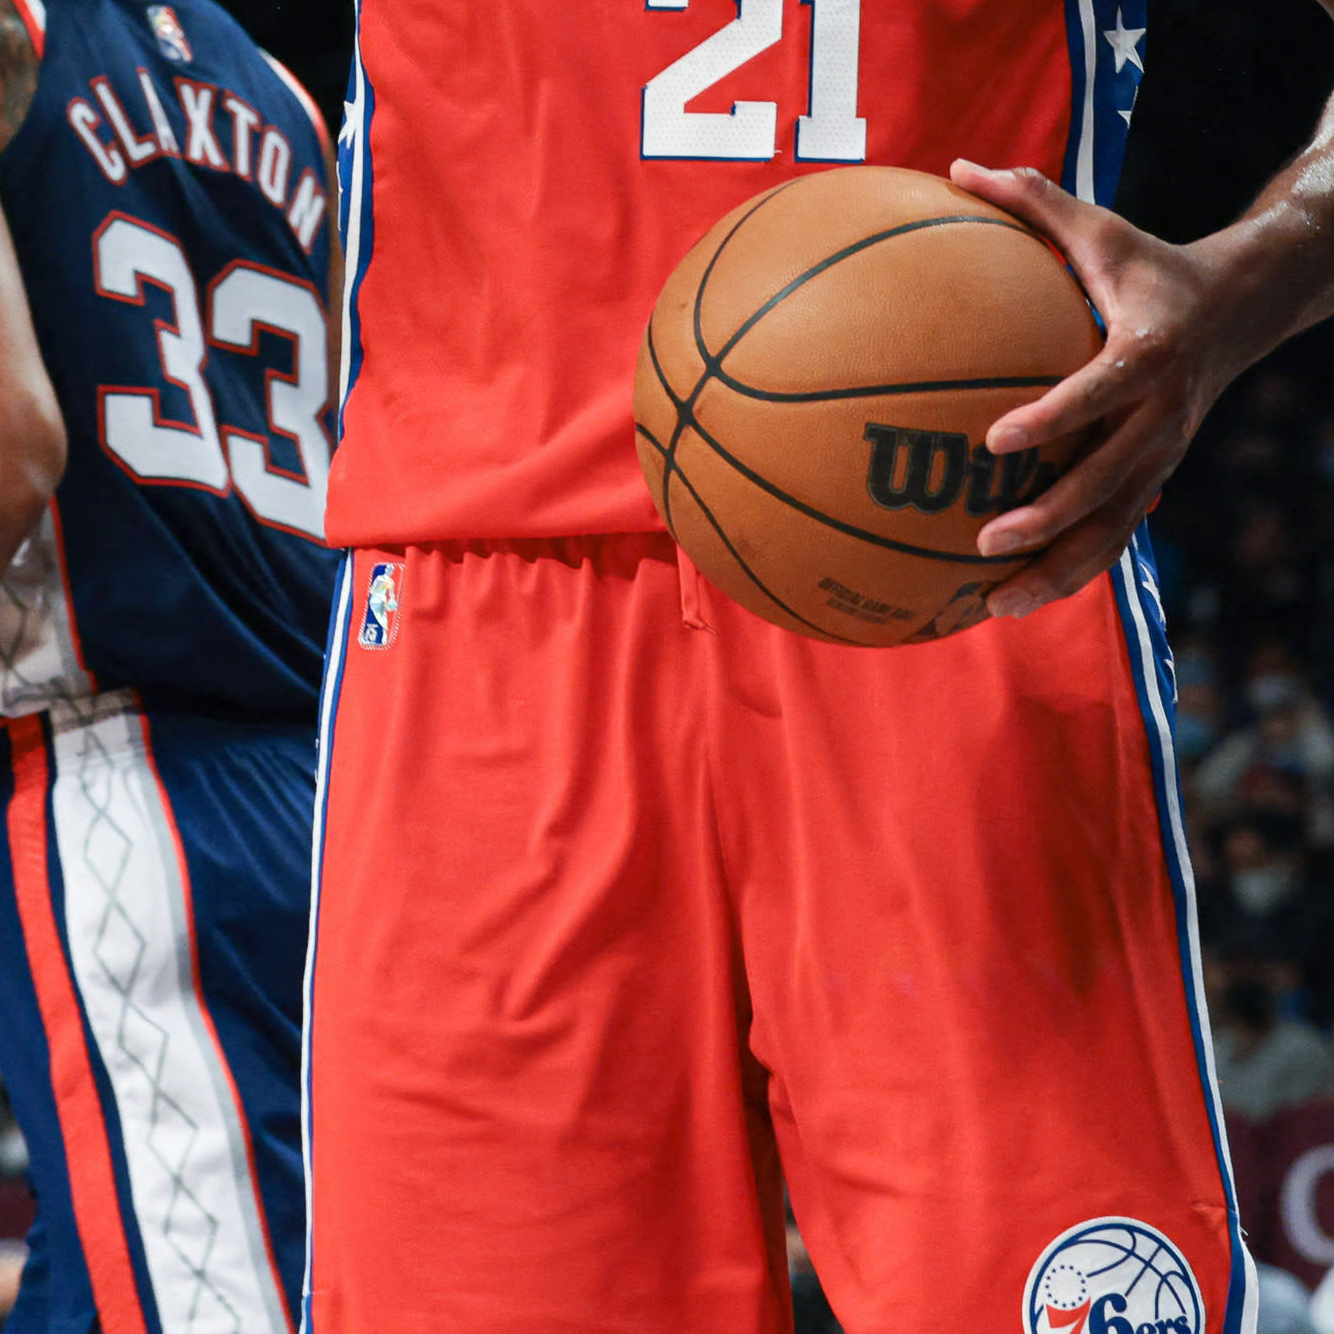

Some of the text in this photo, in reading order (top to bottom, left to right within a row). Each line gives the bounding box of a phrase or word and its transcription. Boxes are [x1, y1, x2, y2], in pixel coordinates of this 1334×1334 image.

[67, 66, 327, 255] CLAXTON
[92, 209, 332, 548] 33
[864, 422, 1057, 518] Wil
